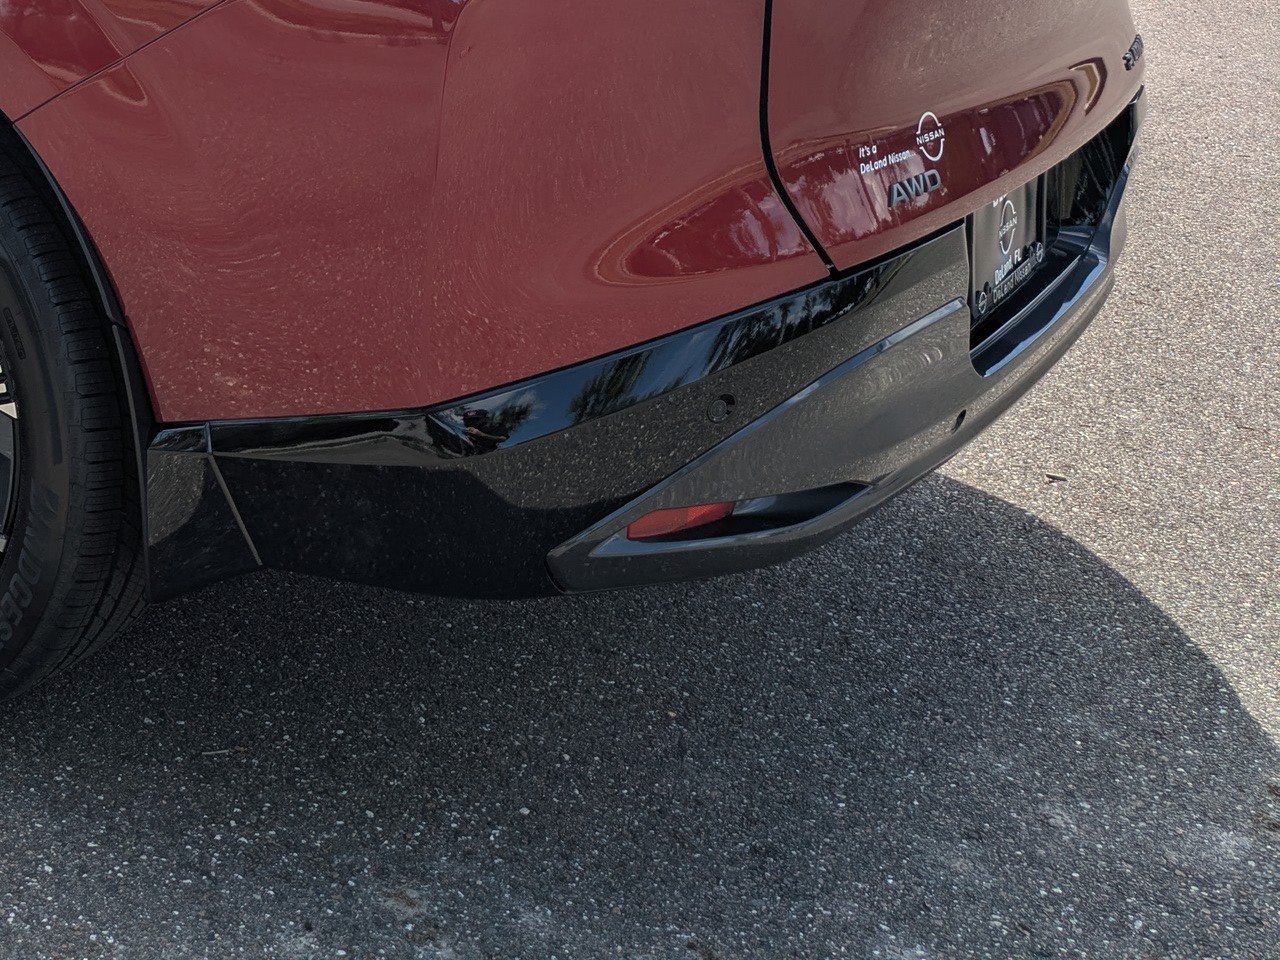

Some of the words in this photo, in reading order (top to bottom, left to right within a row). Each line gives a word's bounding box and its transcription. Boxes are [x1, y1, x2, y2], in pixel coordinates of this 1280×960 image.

[916, 128, 945, 145] NISSAN
[859, 145, 870, 158] It's
[872, 145, 877, 154] a
[860, 156, 887, 174] DeLand
[888, 169, 941, 207] AWD
[1015, 248, 1022, 265] FL
